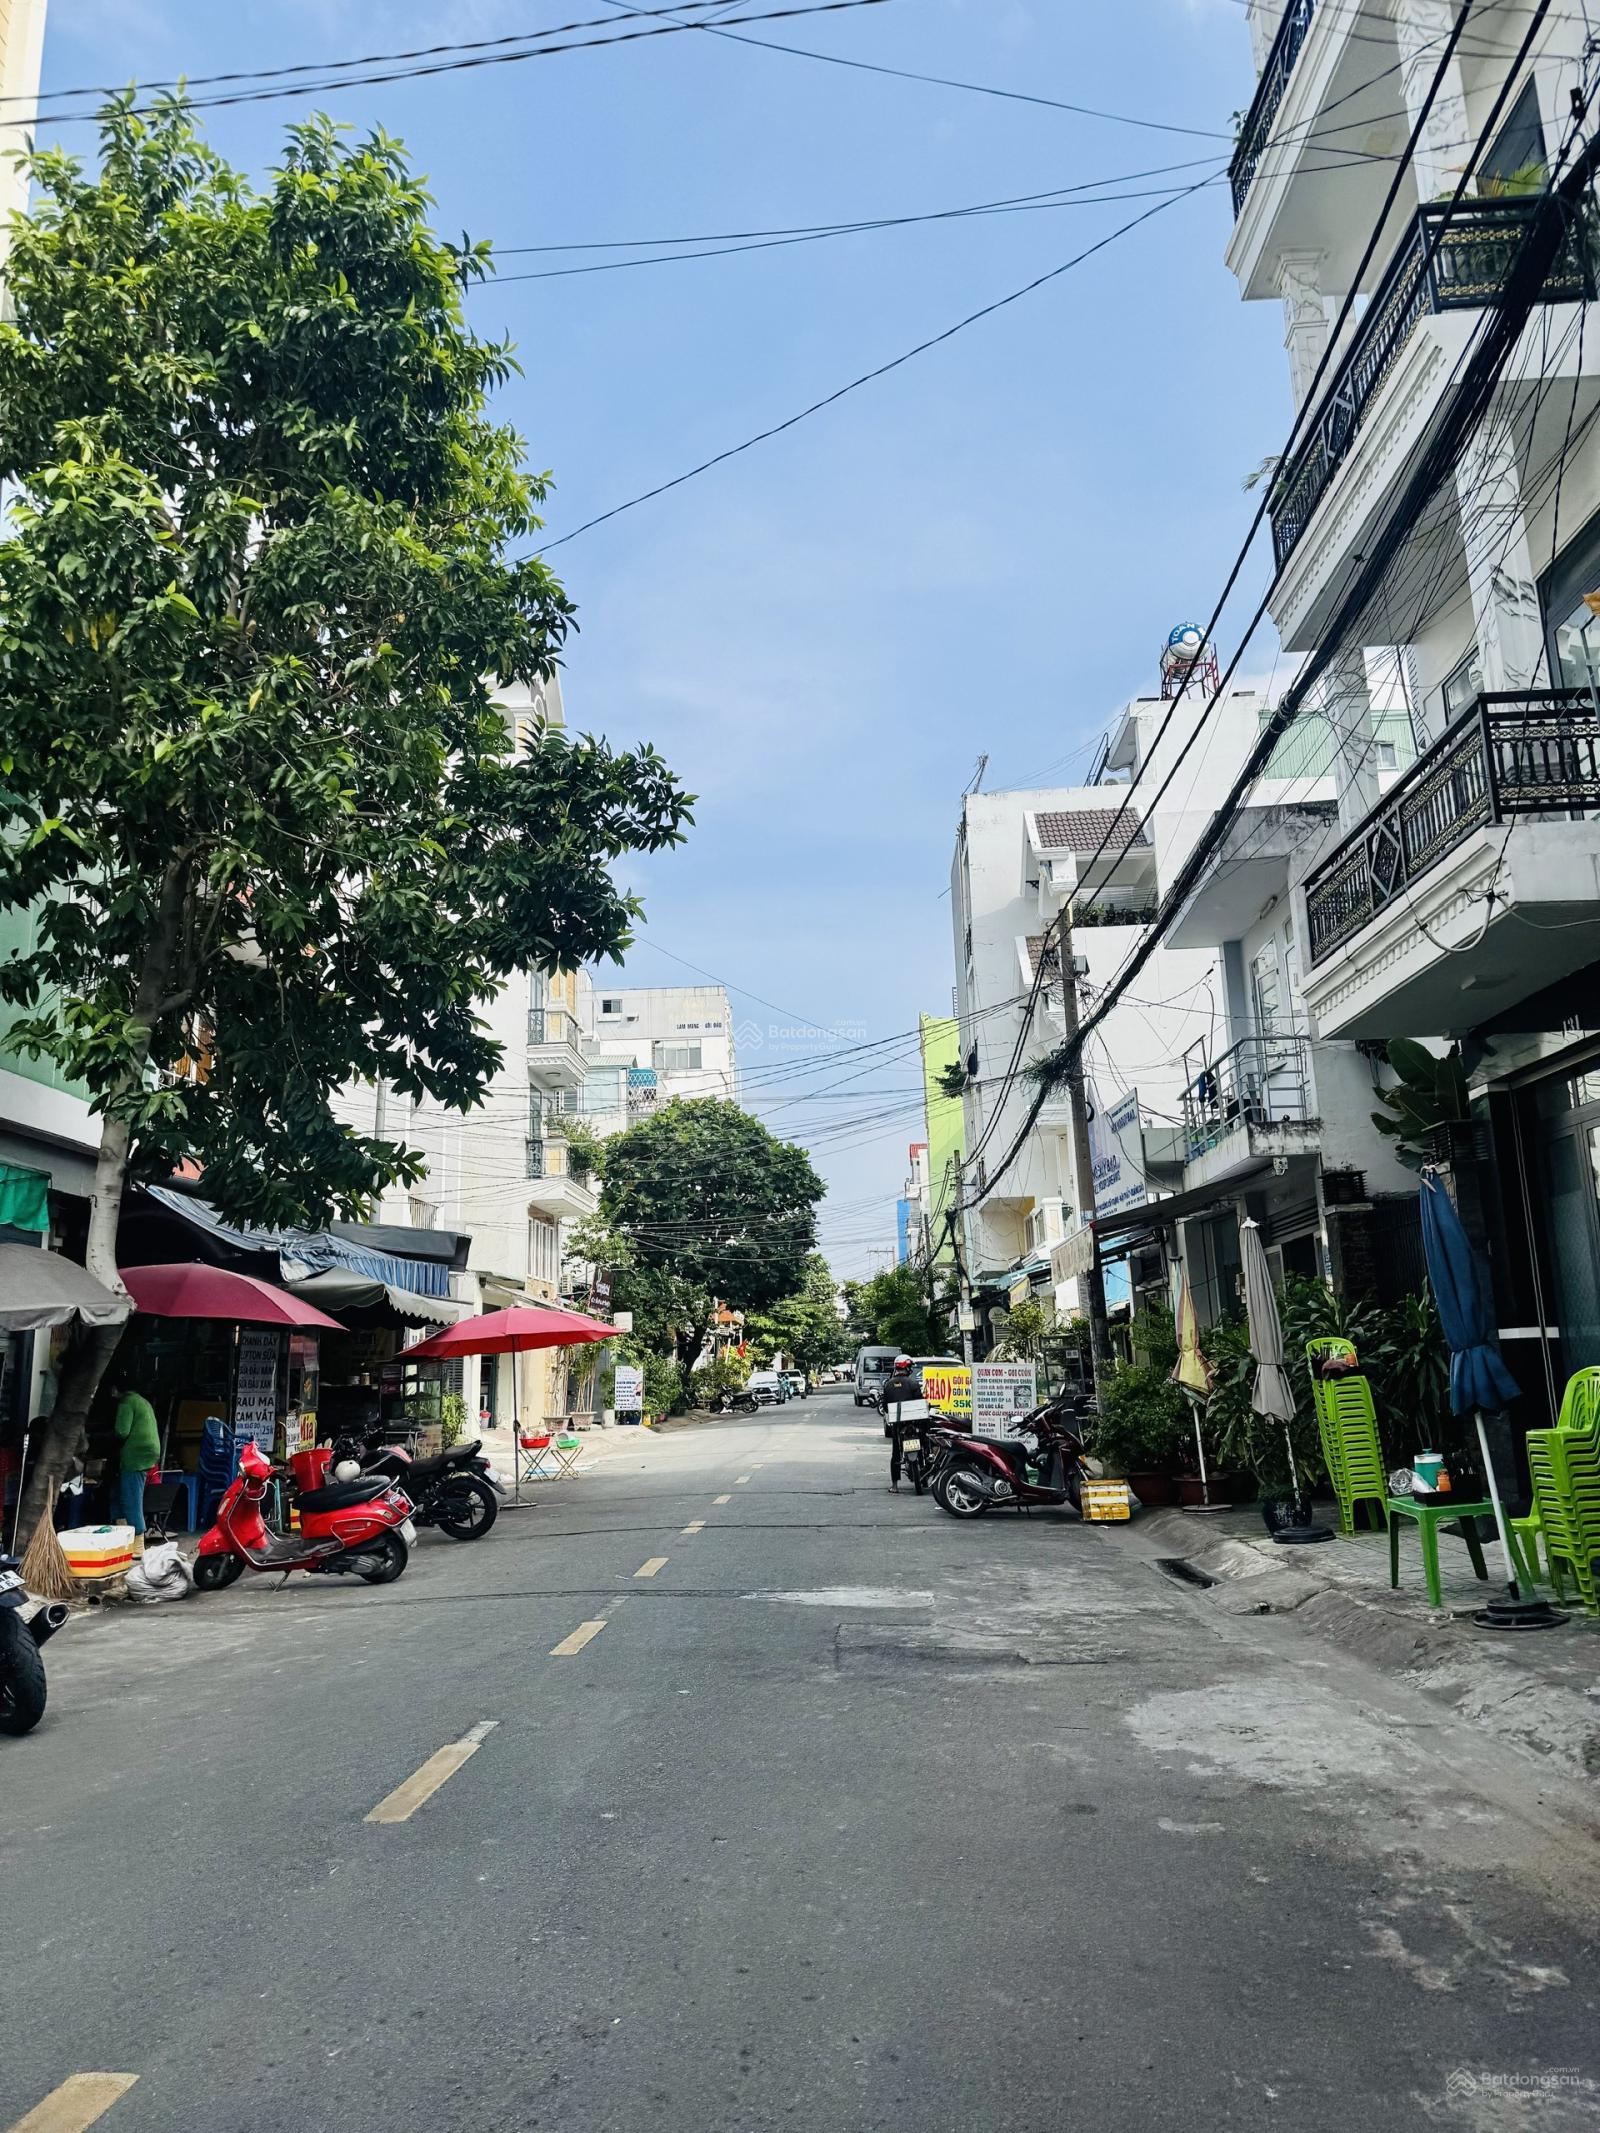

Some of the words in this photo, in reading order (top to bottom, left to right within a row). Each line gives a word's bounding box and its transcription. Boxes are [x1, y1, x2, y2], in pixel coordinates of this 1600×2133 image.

[923, 1372, 946, 1400] CHÁO
[236, 1397, 255, 1407] RAU
[953, 1399, 972, 1408] 35K
[236, 1411, 253, 1422] CAM
